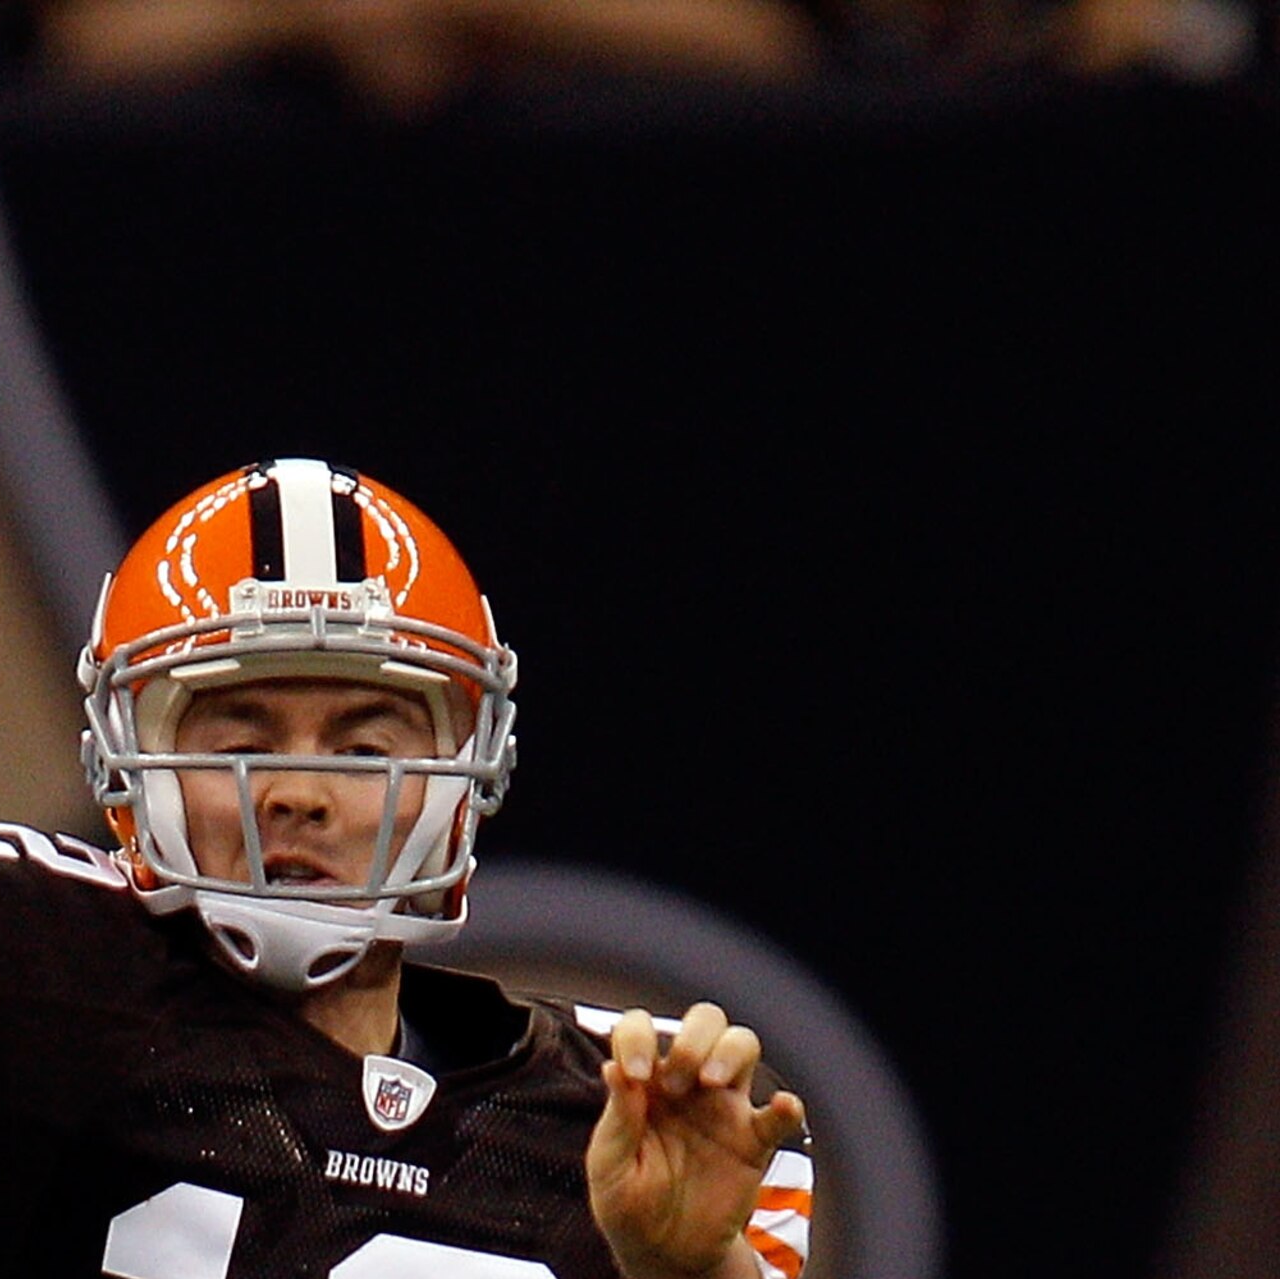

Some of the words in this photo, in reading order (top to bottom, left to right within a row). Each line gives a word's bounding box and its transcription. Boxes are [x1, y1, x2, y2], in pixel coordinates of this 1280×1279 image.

[268, 589, 352, 610] BROWNS
[376, 1093, 407, 1119] NFL
[325, 1150, 430, 1195] BROWNS
